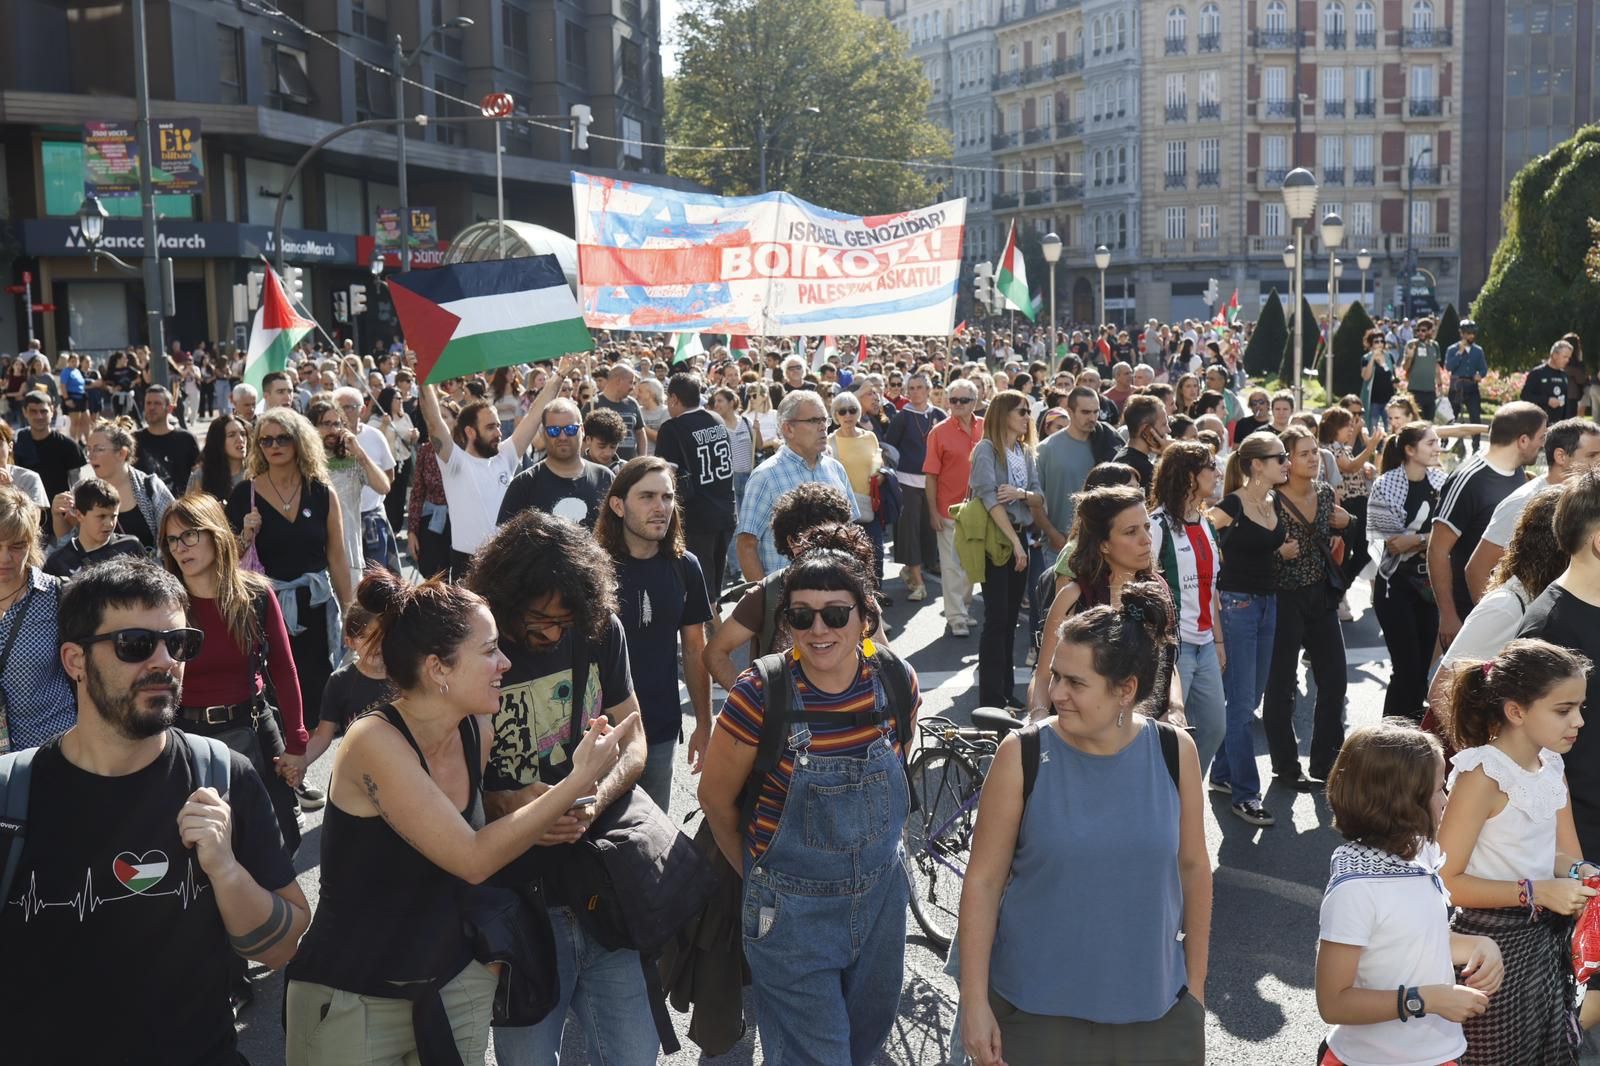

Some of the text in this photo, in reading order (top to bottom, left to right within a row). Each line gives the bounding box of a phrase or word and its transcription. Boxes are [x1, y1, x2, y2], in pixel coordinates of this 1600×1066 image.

[160, 128, 192, 151] Ei!
[788, 221, 843, 247] ISRAEL
[720, 230, 942, 280] BOIKOTA!
[877, 267, 942, 291] ASKATU!
[697, 440, 735, 484] 13
